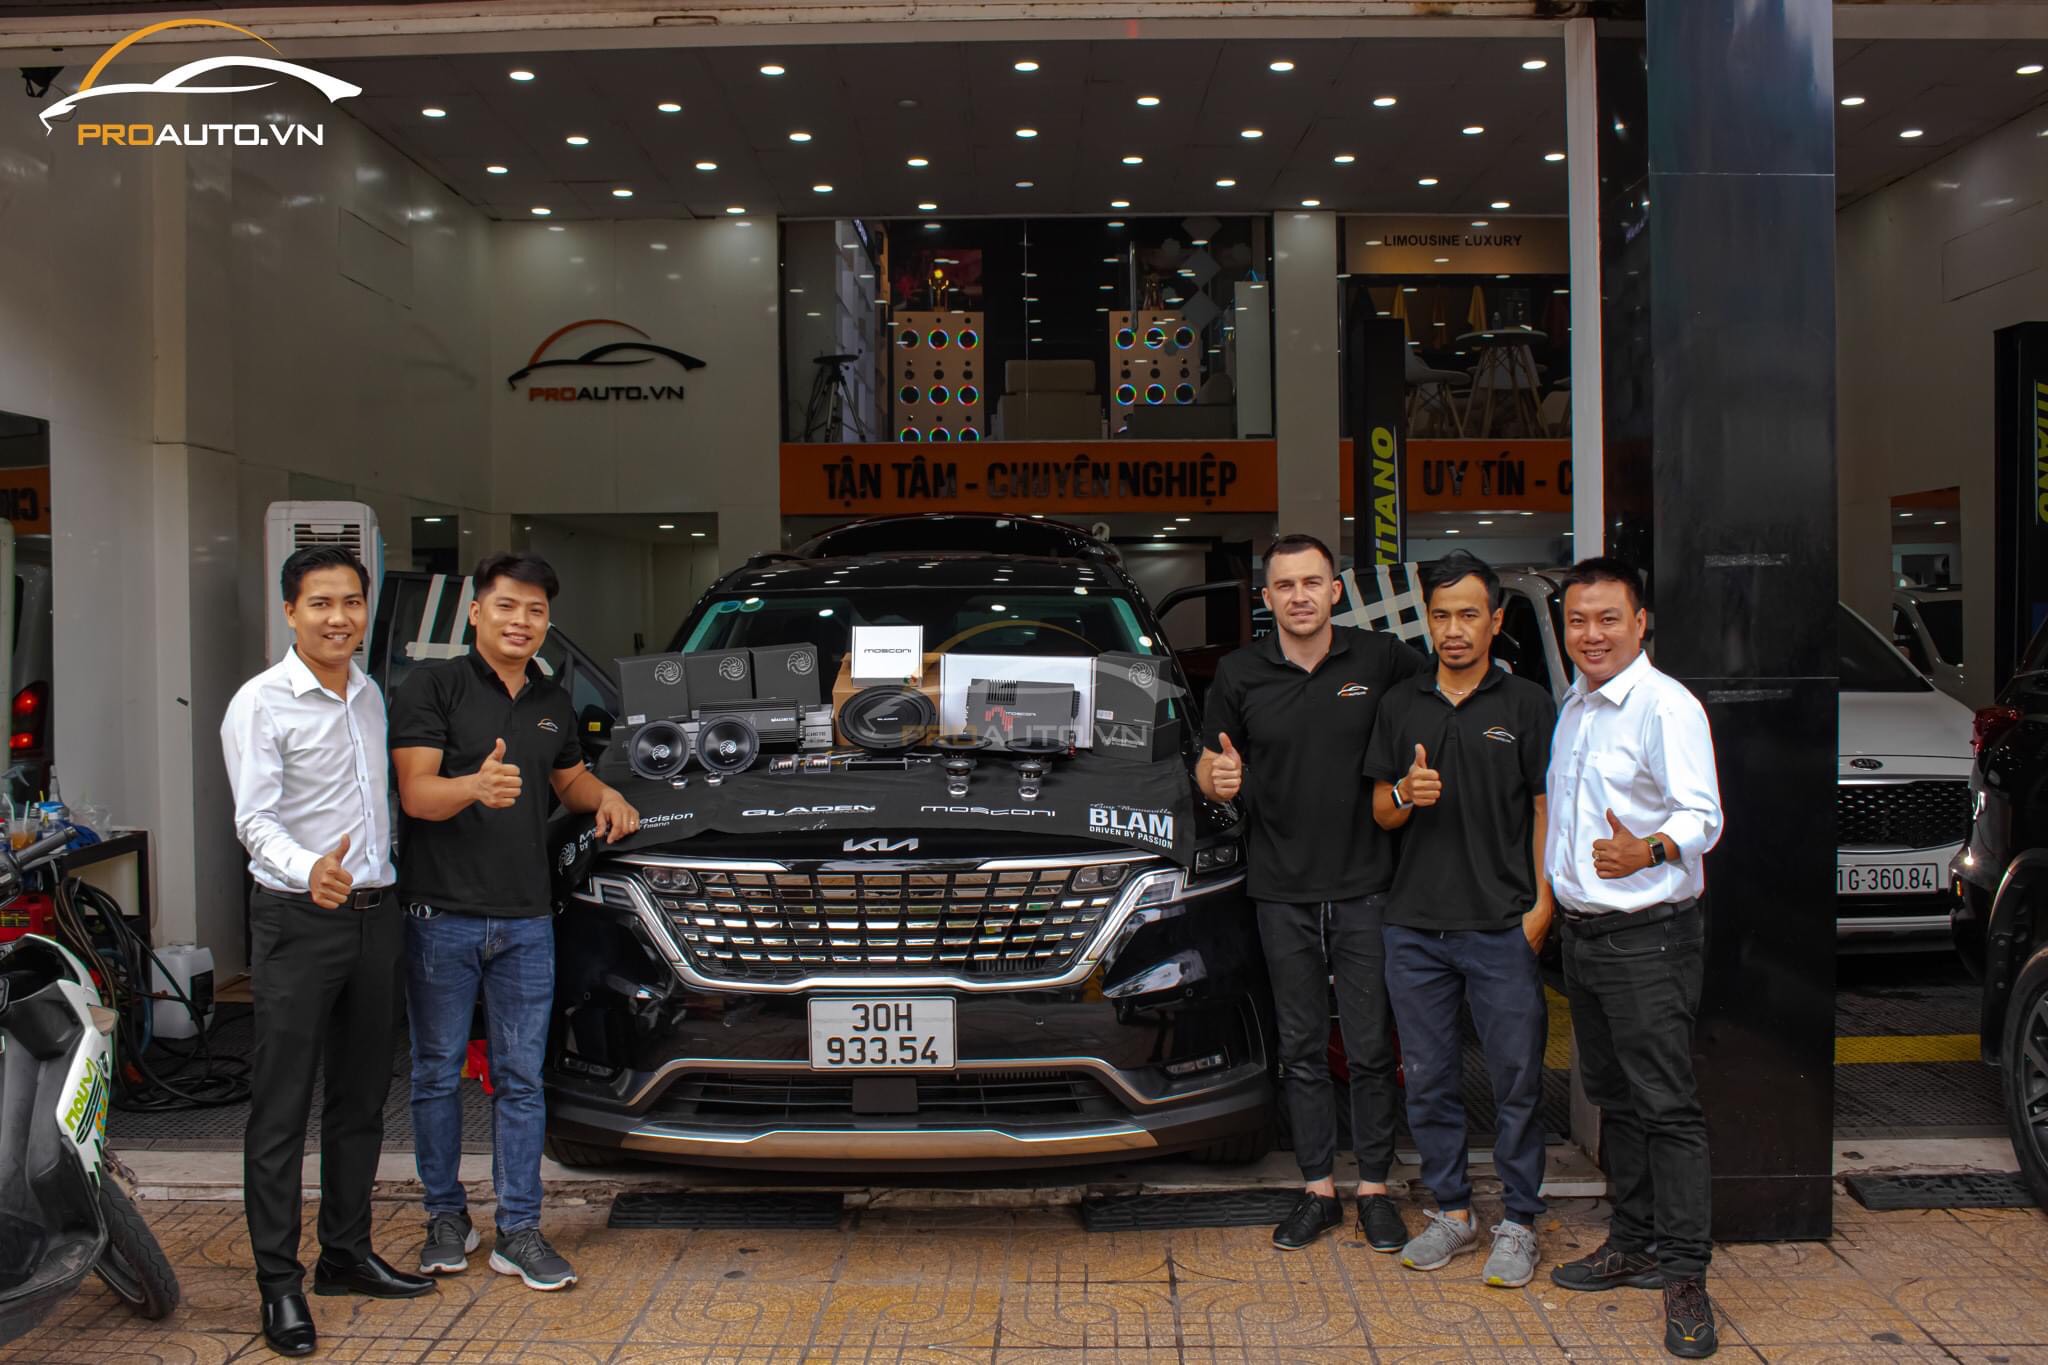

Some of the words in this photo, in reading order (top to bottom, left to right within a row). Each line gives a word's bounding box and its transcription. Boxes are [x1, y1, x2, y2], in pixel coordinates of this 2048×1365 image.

[1384, 234, 1460, 247] LIMOUSINE
[1464, 234, 1523, 247] LUXURY
[528, 386, 685, 401] PROAUTO.VN
[823, 455, 882, 507] TẬN
[891, 455, 957, 498] TÂM
[987, 453, 1110, 498] CHUYÊN
[1120, 452, 1238, 506] NGHIỆP
[1423, 459, 1469, 496] UY
[1475, 451, 1525, 496] TÍN
[639, 812, 694, 824] ecision
[1089, 808, 1174, 840] BLAM
[842, 838, 919, 852] KIA
[1089, 825, 1121, 836] DRIVEN
[1124, 830, 1135, 839] BY
[1137, 832, 1173, 850] PASSION
[1837, 867, 1933, 891] 1G-360.84
[852, 1003, 912, 1032] 30H
[826, 1036, 939, 1065] 933.54
